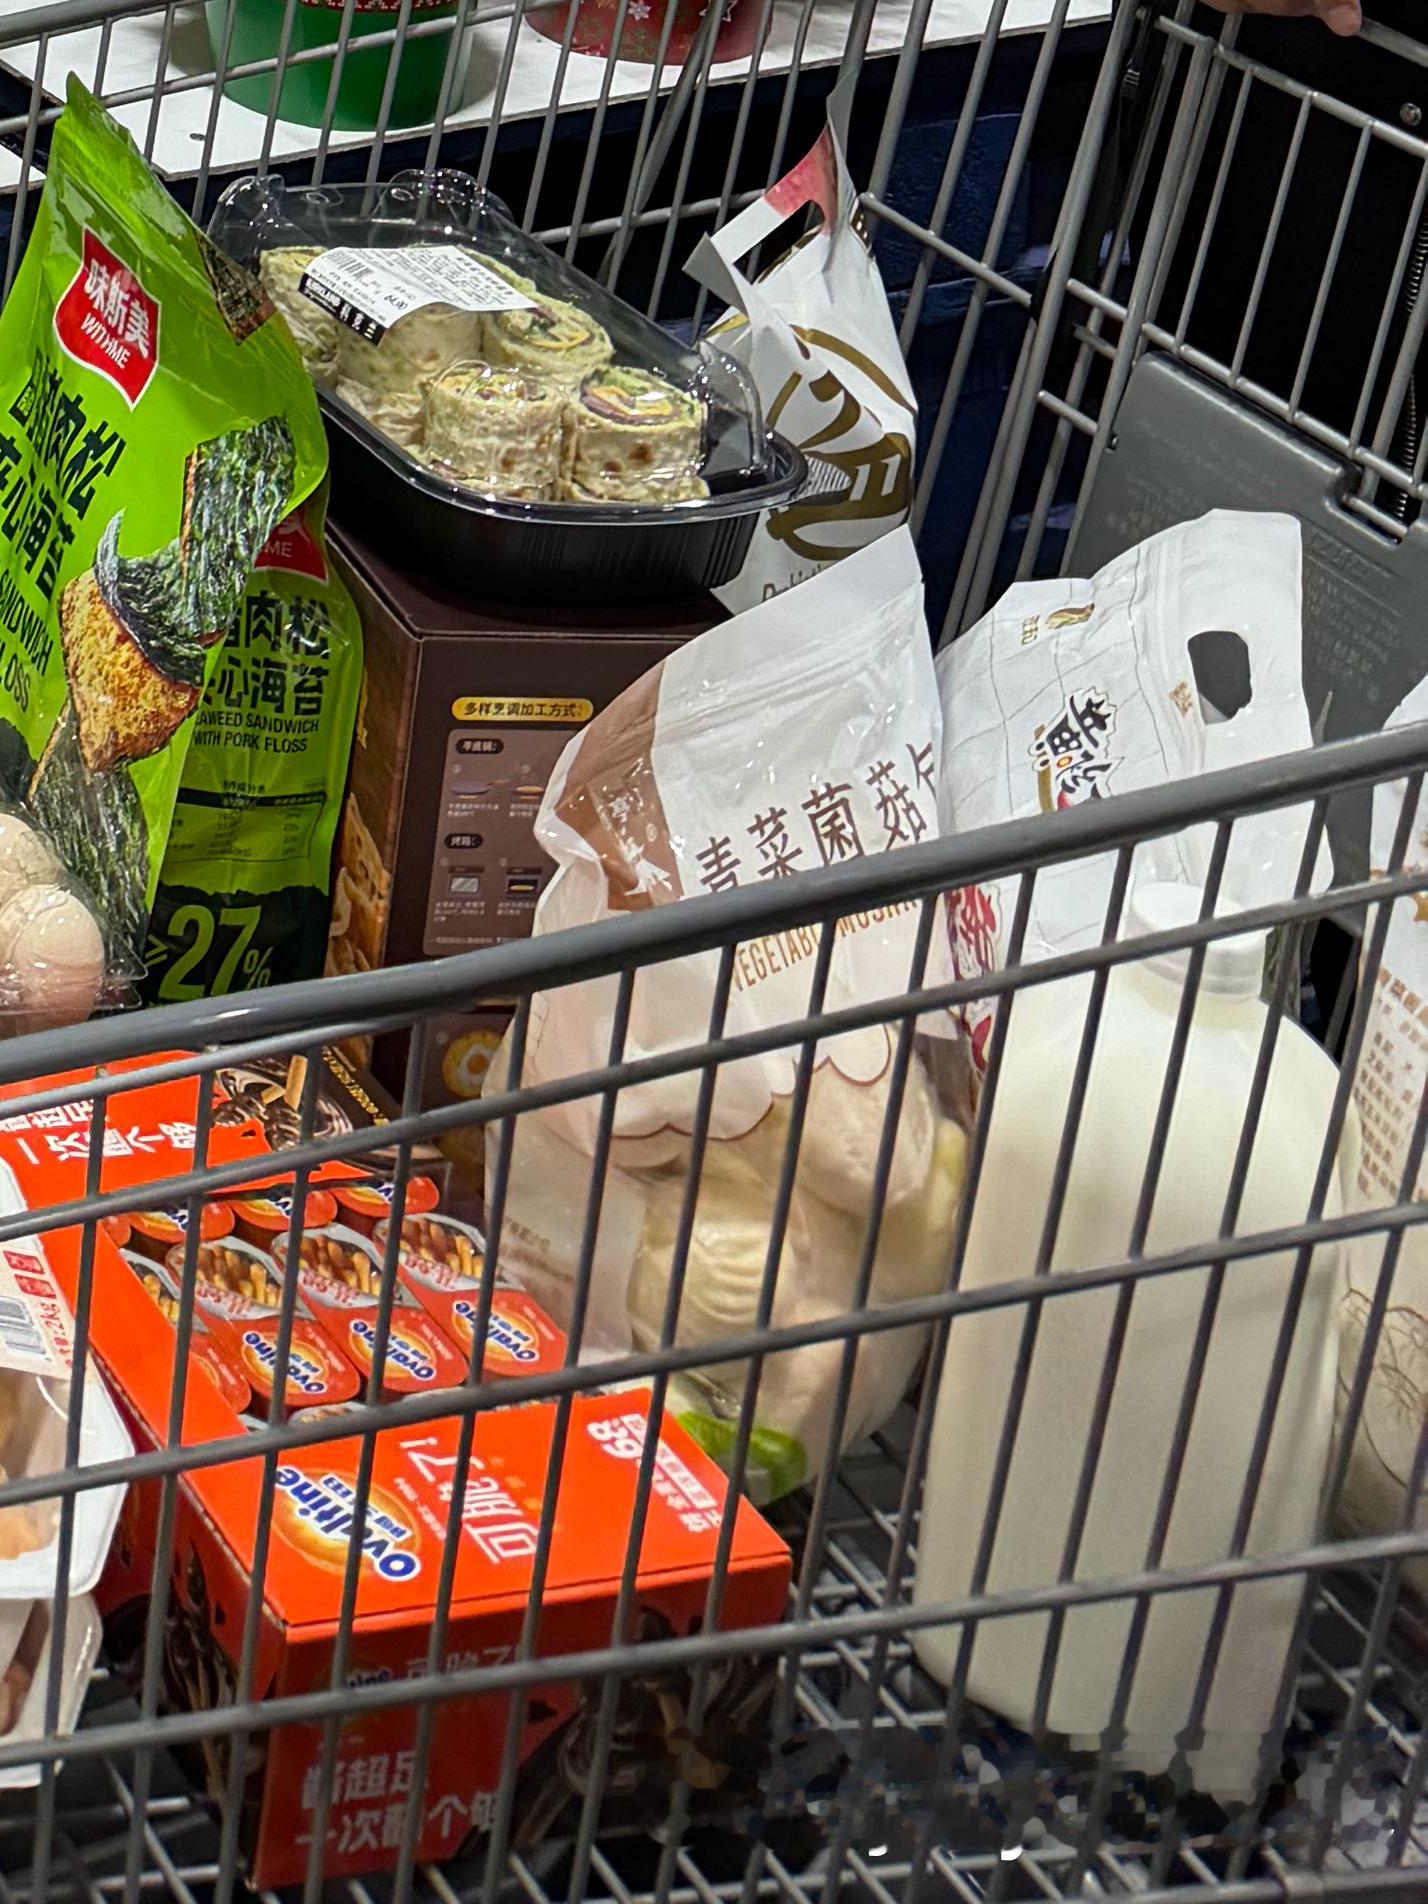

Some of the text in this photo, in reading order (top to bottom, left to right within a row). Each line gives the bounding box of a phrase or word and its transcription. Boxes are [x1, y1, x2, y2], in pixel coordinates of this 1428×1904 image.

[224, 732, 260, 749] PORK
[264, 737, 308, 754] FLOSS
[246, 712, 319, 734] SANDWICH
[732, 924, 821, 992] EGETAB
[349, 1320, 436, 1380] Ovalne
[453, 1300, 540, 1363] Ovalne
[243, 1332, 327, 1394] Ovaine
[275, 1466, 420, 1580] Ovltine
